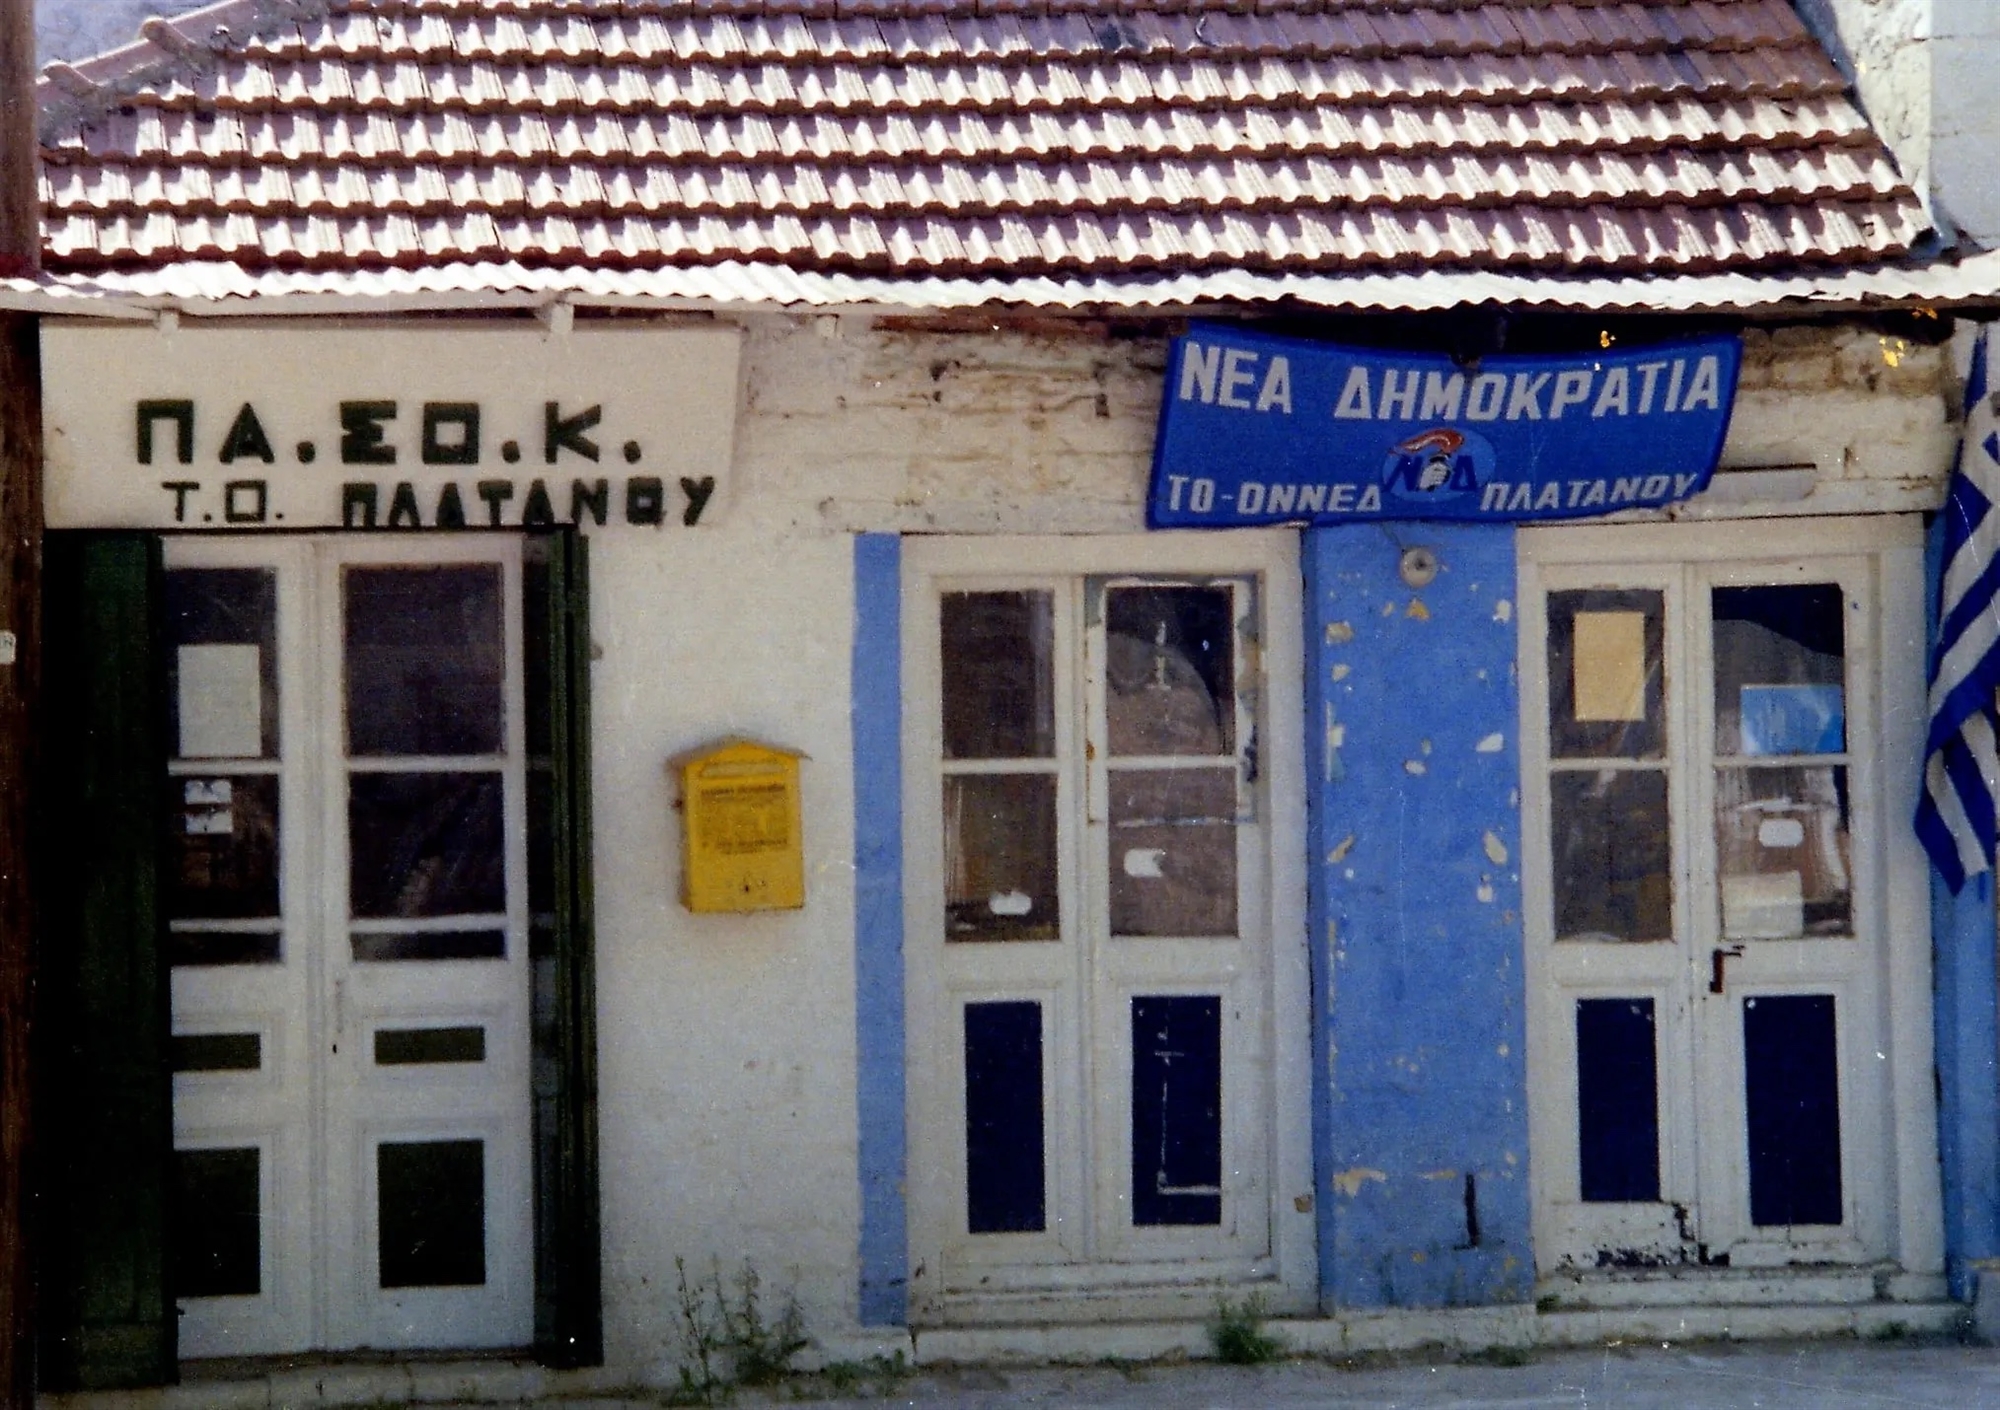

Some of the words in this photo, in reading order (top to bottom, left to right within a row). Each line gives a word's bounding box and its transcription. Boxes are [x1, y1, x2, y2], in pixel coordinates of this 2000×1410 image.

[1179, 341, 1292, 414] ΝΕΑ
[1334, 355, 1720, 422] ΔΗΜΟΚΡΑΤΙΑ
[162, 481, 284, 523] Τ.Ο.
[342, 476, 716, 527] ΠΛΑΤΑΝΟΥ
[1479, 472, 1698, 512] ΠΛΑΤΑΝΟΥ
